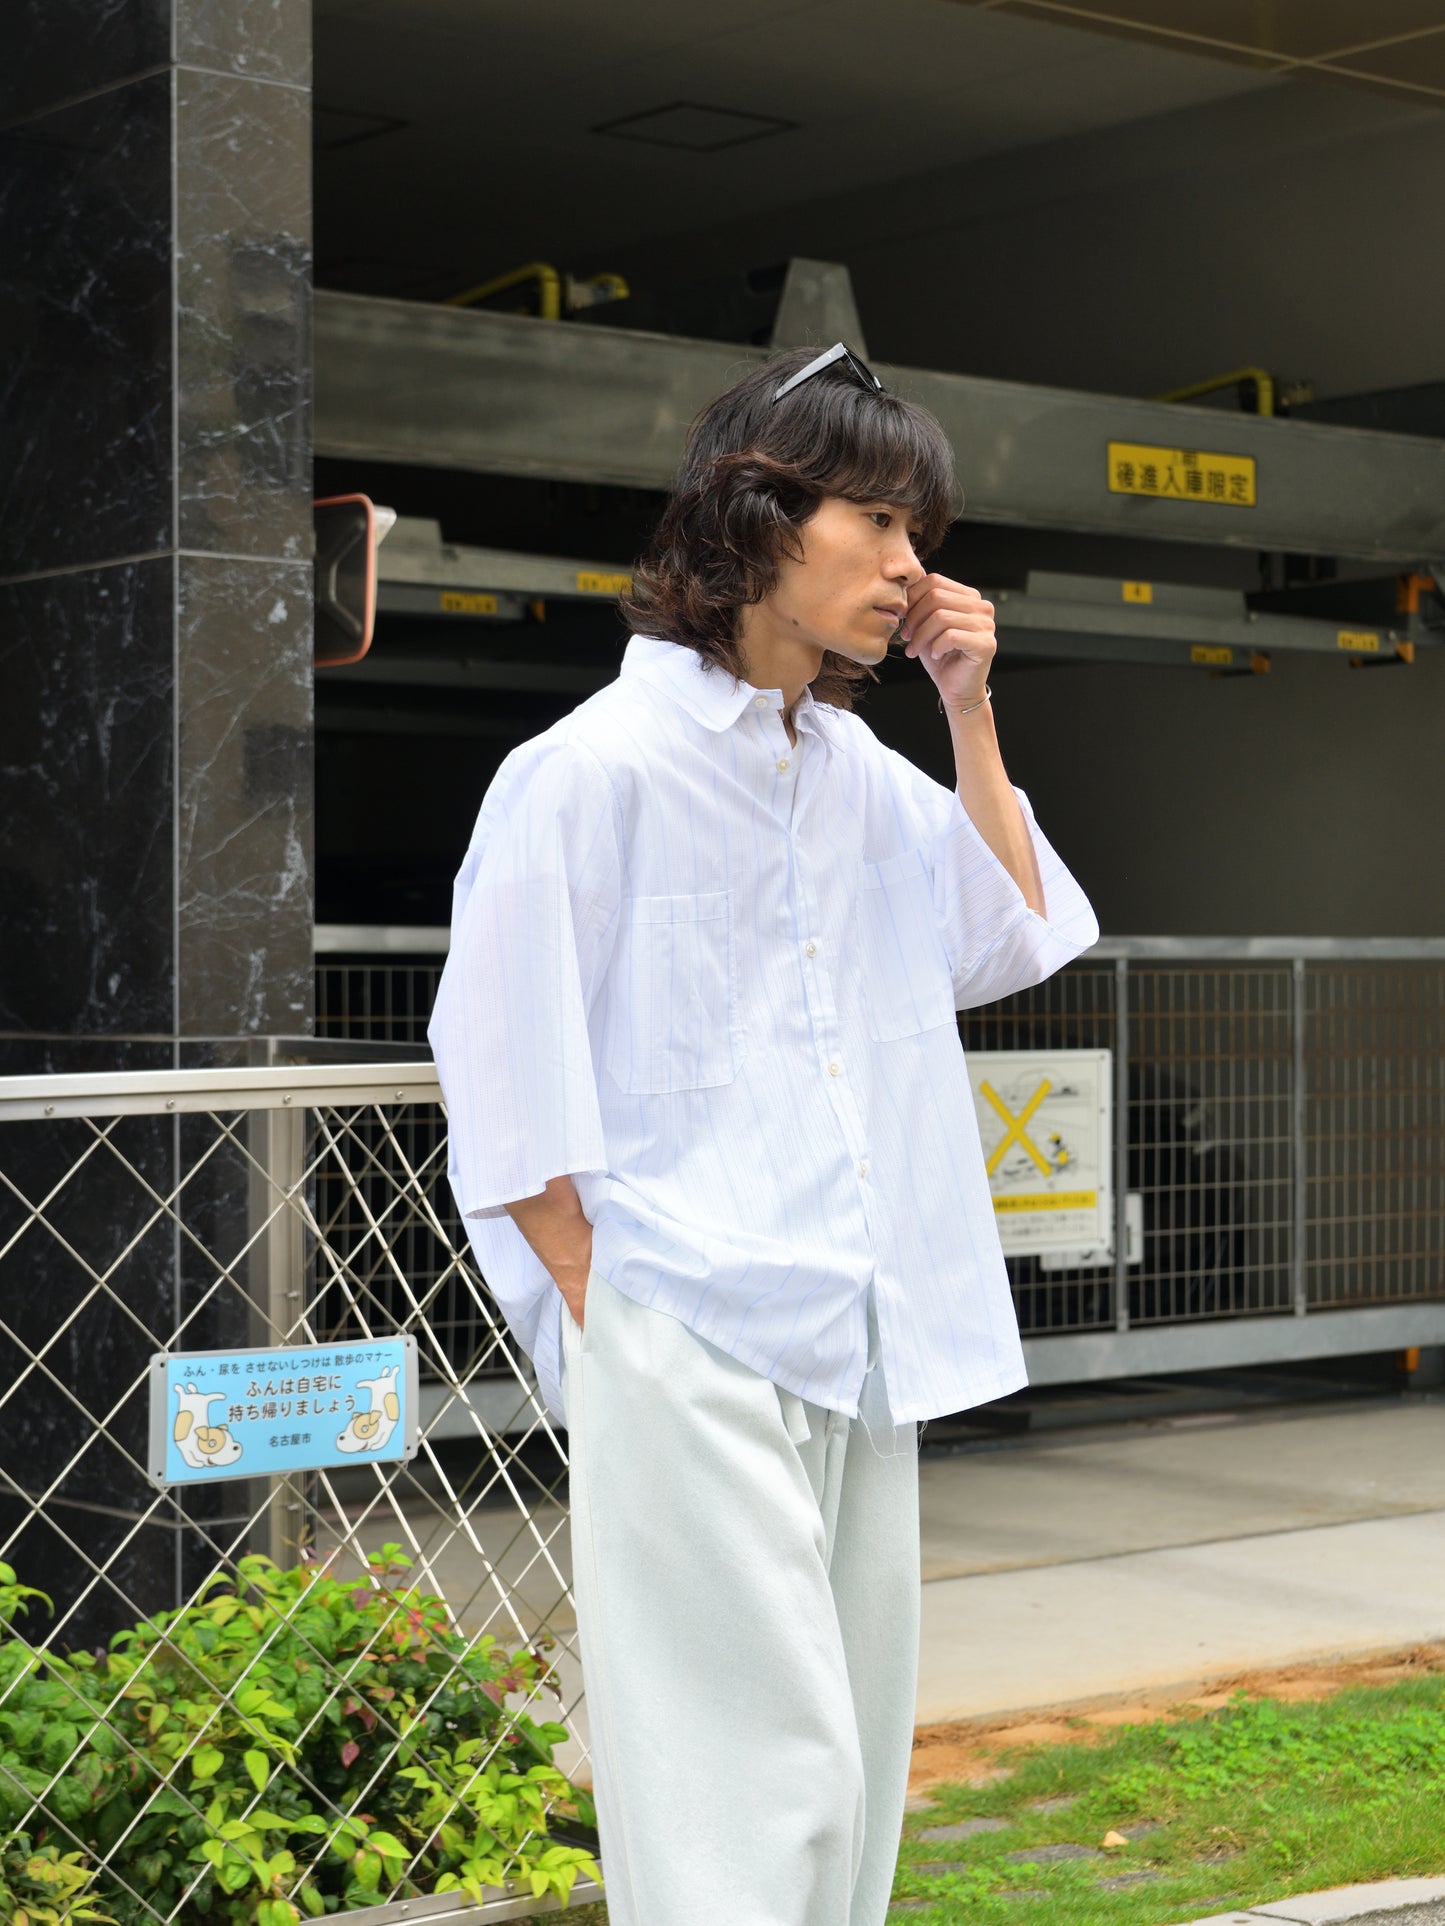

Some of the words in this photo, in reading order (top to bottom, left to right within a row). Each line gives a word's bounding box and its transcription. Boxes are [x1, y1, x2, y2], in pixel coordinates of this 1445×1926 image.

[1116, 461, 1249, 502] 後進入庫限定
[245, 1357, 332, 1374] させないしつけは
[335, 1351, 393, 1367] 散歩のマナー
[246, 1374, 342, 1398] ふんは自宅に
[228, 1393, 356, 1423] 持ち帰りましょう
[269, 1432, 312, 1448] 名古屋市
